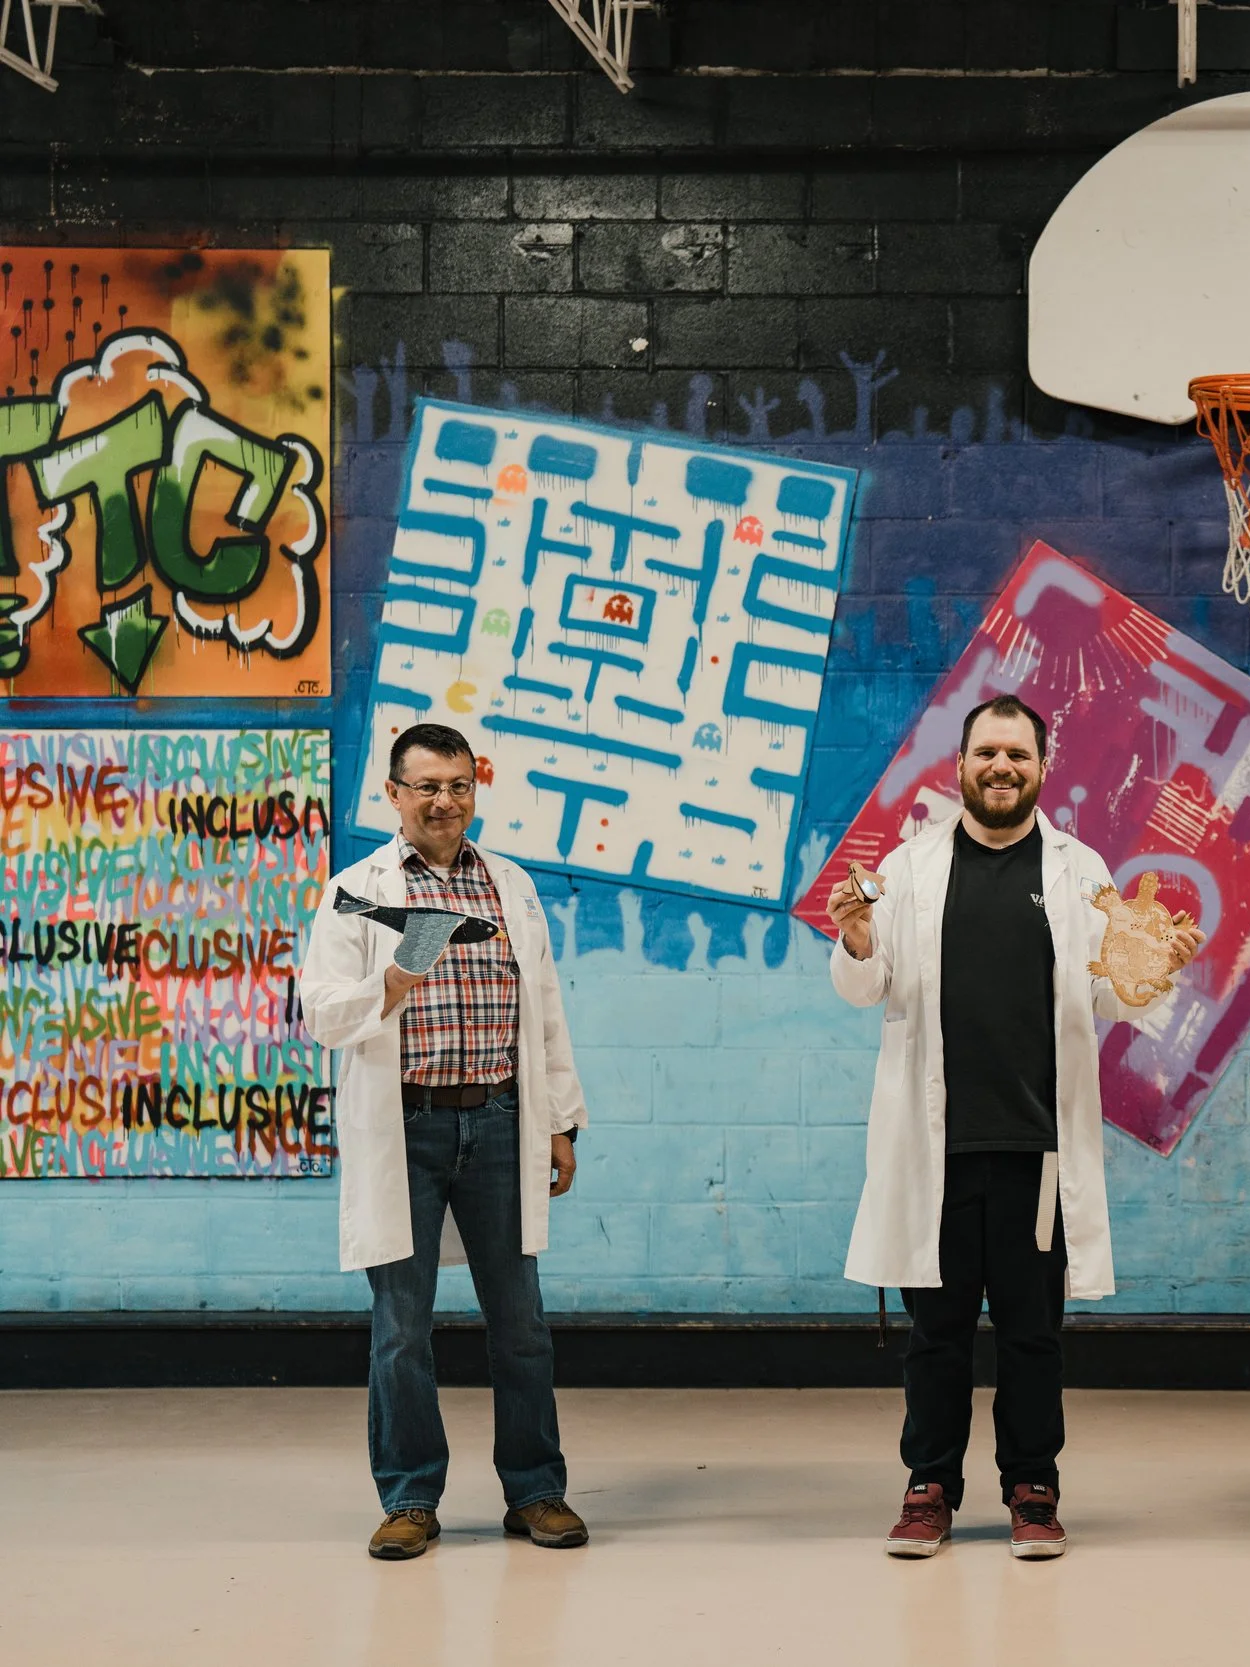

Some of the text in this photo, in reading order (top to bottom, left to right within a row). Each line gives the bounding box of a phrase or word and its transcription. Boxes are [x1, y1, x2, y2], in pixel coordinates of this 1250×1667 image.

[0, 389, 300, 600] TC
[127, 733, 330, 785] INCLUSIVE
[0, 918, 141, 966] LUSIVE
[122, 1083, 336, 1133] INCLUSIVE
